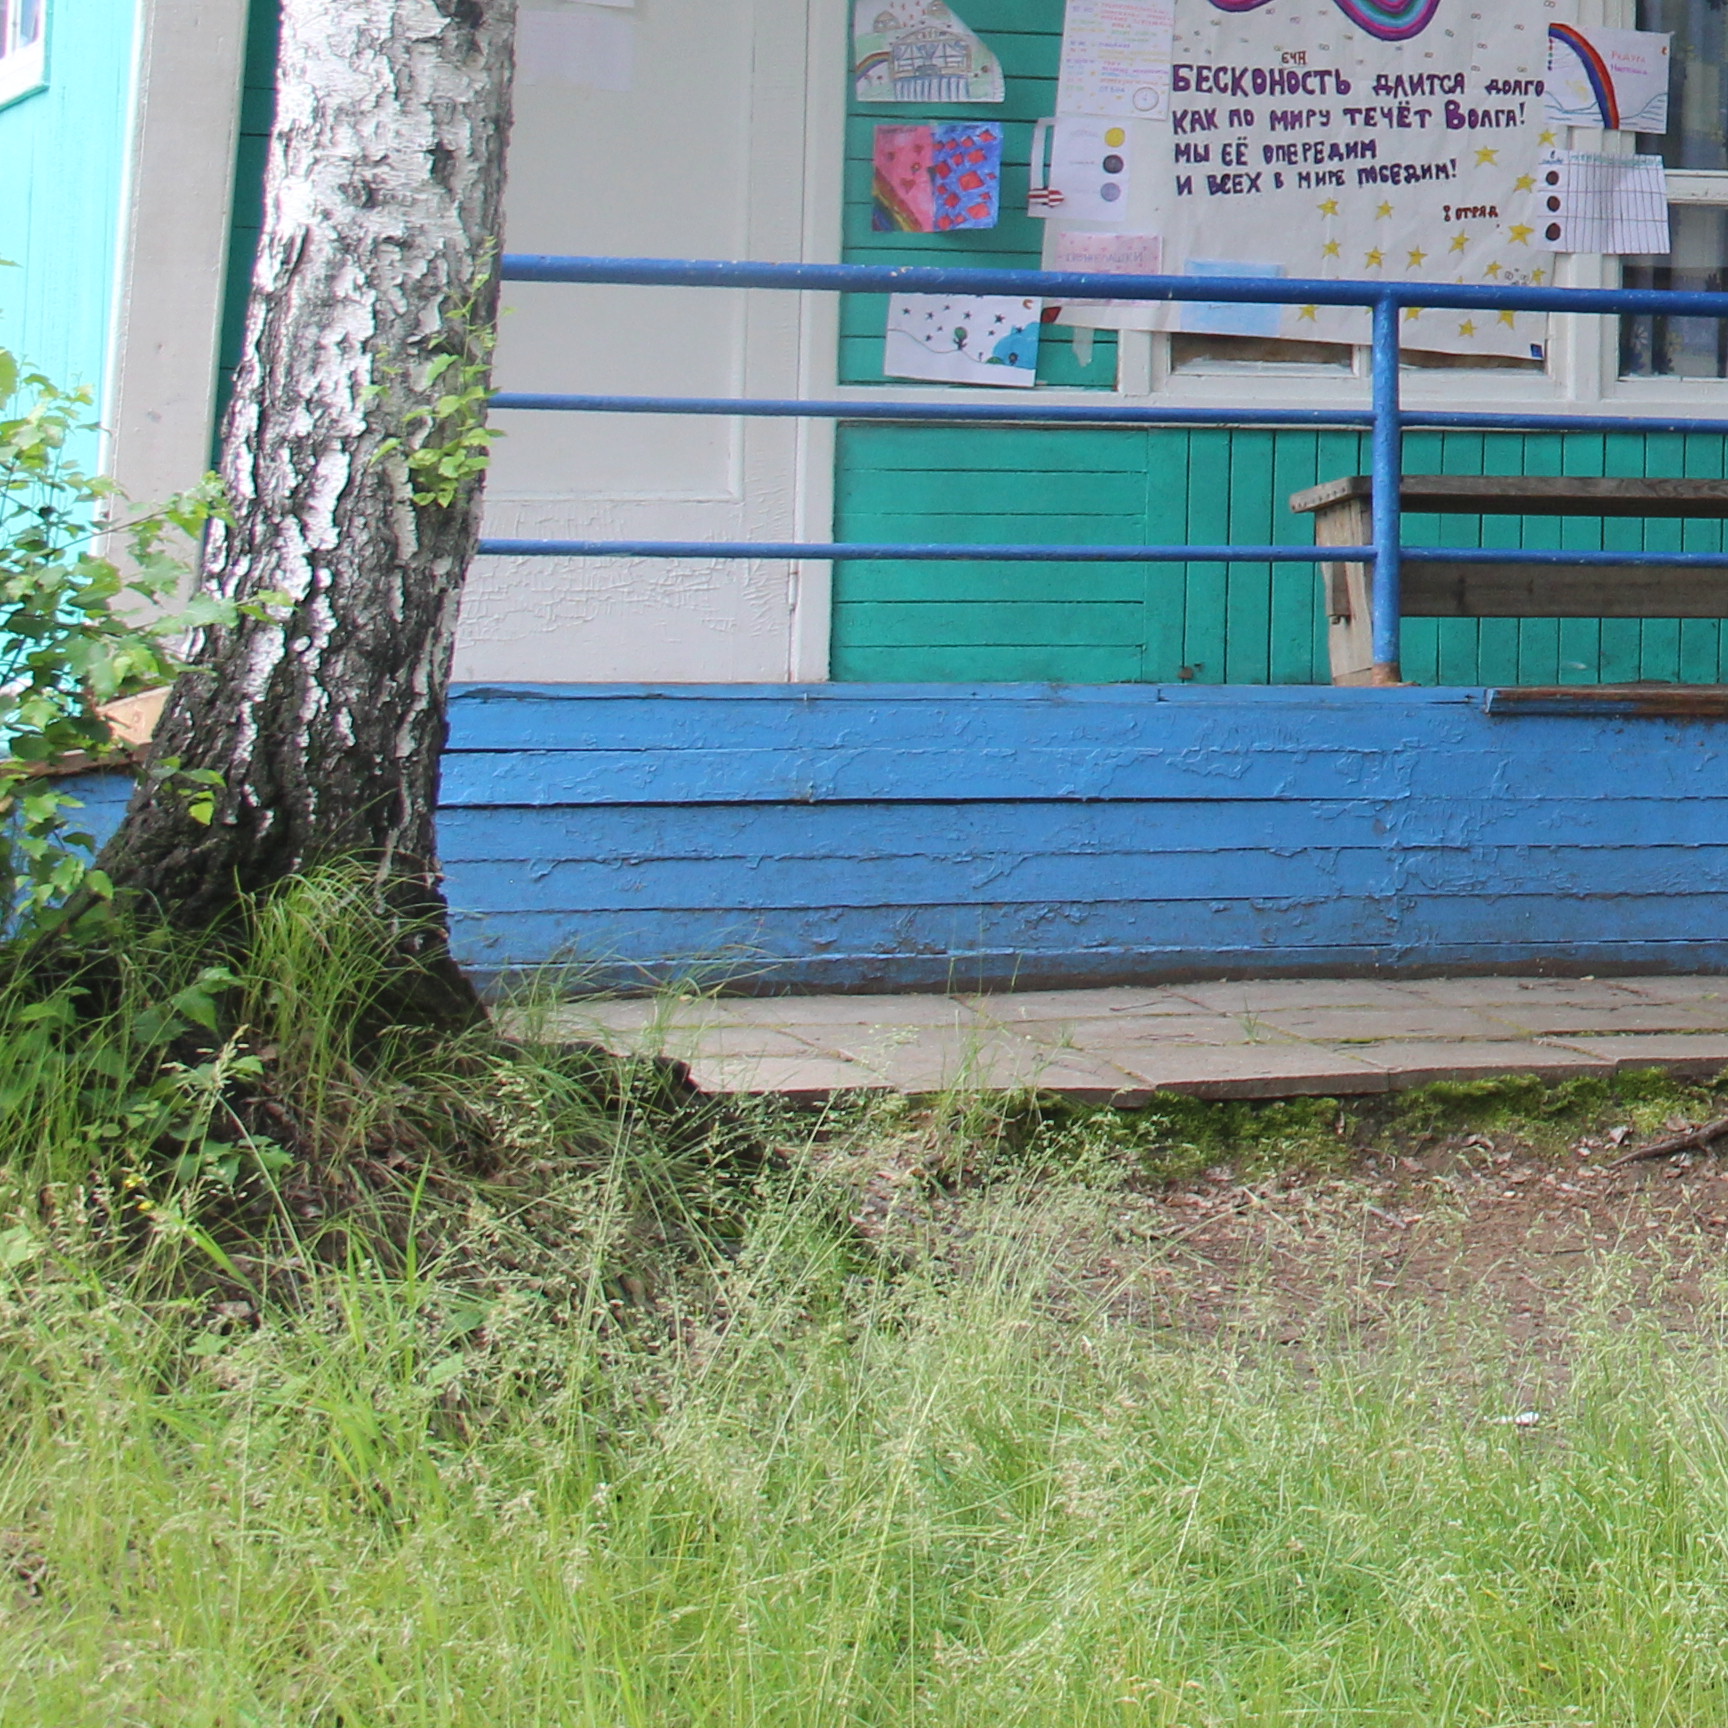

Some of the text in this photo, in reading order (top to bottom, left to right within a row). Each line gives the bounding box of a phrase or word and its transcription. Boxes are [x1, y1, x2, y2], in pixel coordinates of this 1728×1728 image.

[1172, 64, 1351, 97] БЕСКОНОСТЬ
[1372, 72, 1465, 98] ДЛИТСЯ
[1484, 78, 1545, 97] ДОЛГО
[1172, 108, 1219, 135] КАК
[1228, 108, 1255, 127] ПО
[1269, 108, 1331, 131] МИРУ
[1342, 101, 1433, 128] ТЕЧЁТ
[1174, 137, 1377, 166] МЫ ЕЁ ОПЕРЕДИМ
[1176, 159, 1457, 196] И ВСЕХ В МИРЕ ПОБЕДИМ!
[1455, 205, 1499, 221] ОТРЯД
